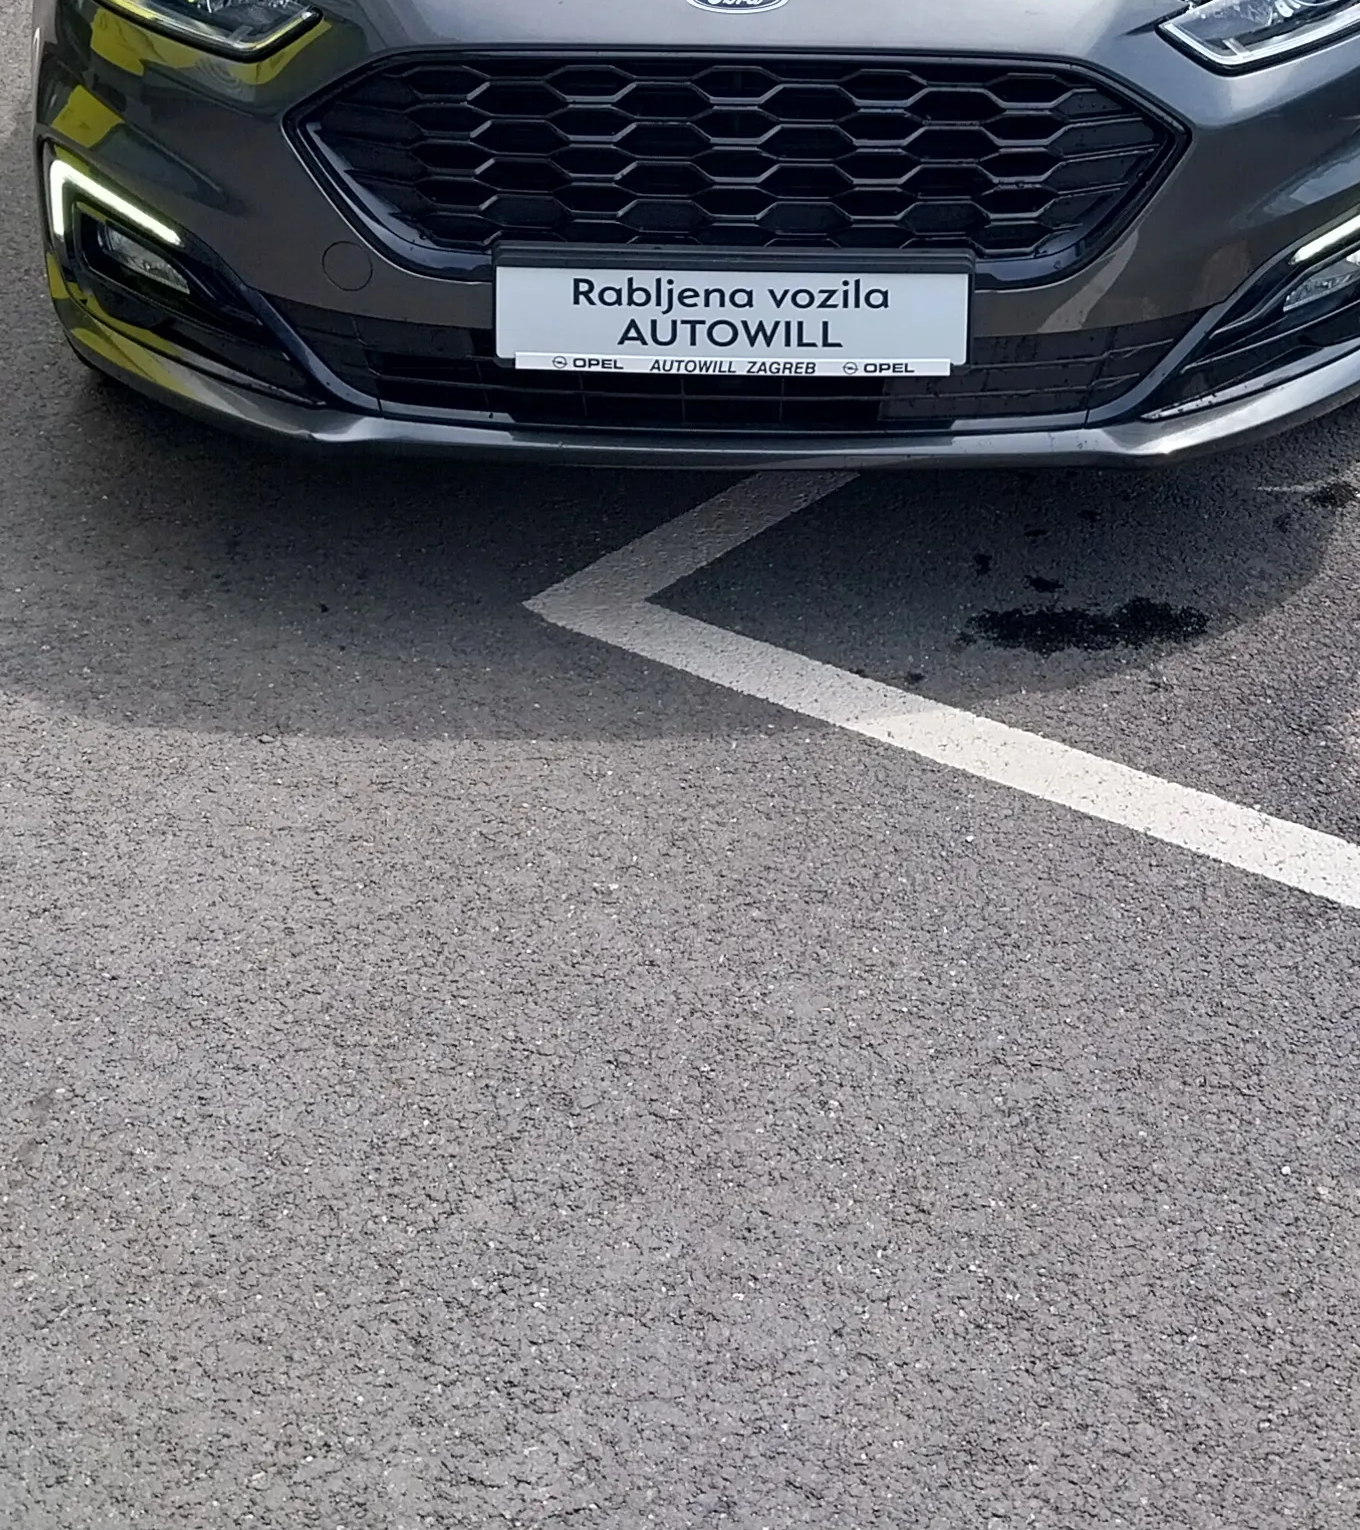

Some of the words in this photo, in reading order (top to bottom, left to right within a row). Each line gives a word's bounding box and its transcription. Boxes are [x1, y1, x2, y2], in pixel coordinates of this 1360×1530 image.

[572, 276, 754, 315] Rabljena
[767, 278, 890, 309] vozila
[617, 318, 843, 348] AUTOWILL
[573, 358, 624, 370] OPEL
[650, 358, 737, 374] AUTOWILL
[746, 360, 817, 375] ZAGREB
[863, 362, 915, 373] OPEL
